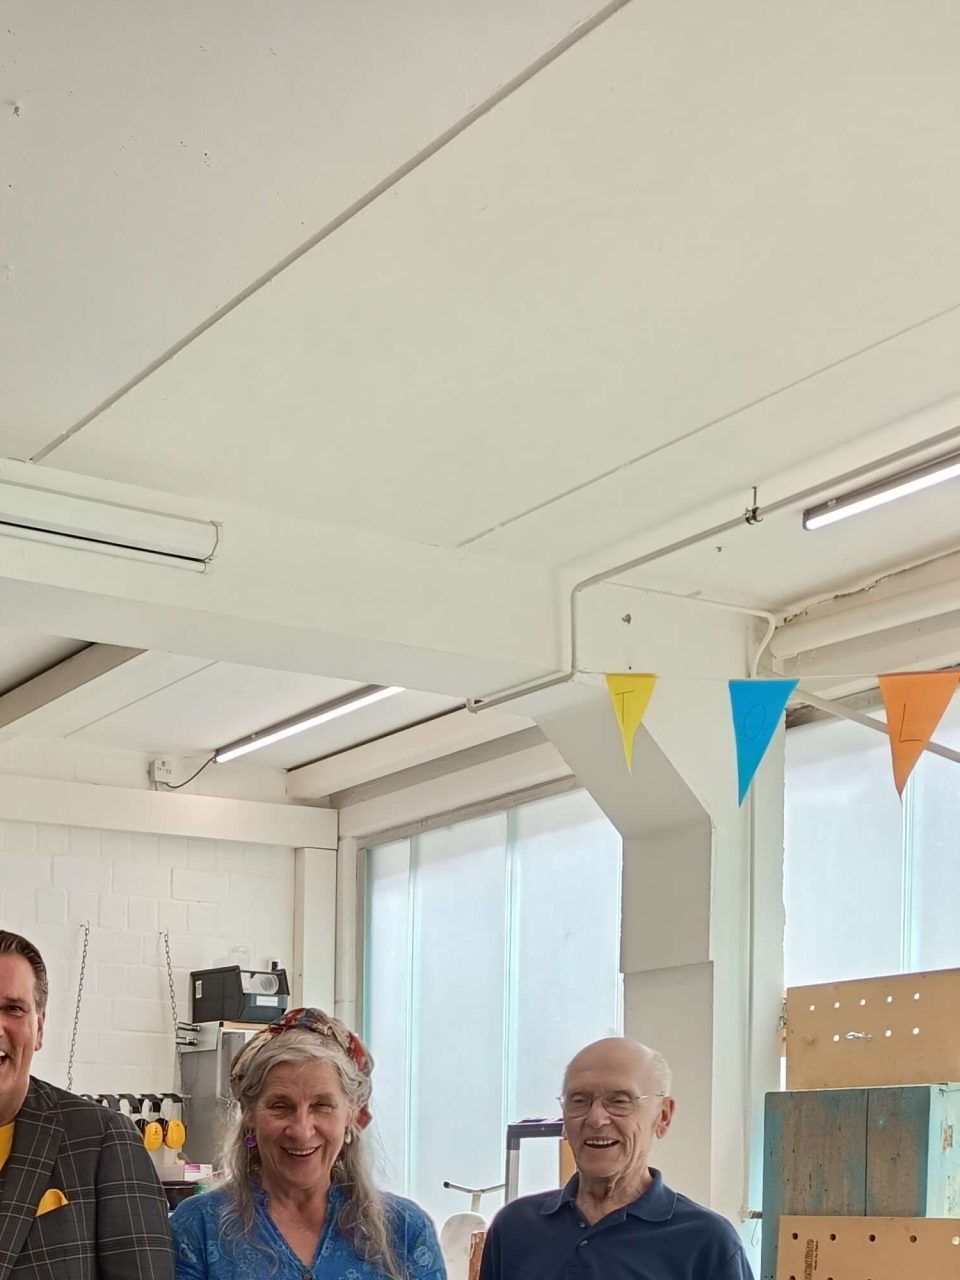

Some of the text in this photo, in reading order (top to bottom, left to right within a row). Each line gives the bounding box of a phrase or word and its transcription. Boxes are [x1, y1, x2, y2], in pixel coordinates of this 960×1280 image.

[615, 690, 922, 743] T O L
